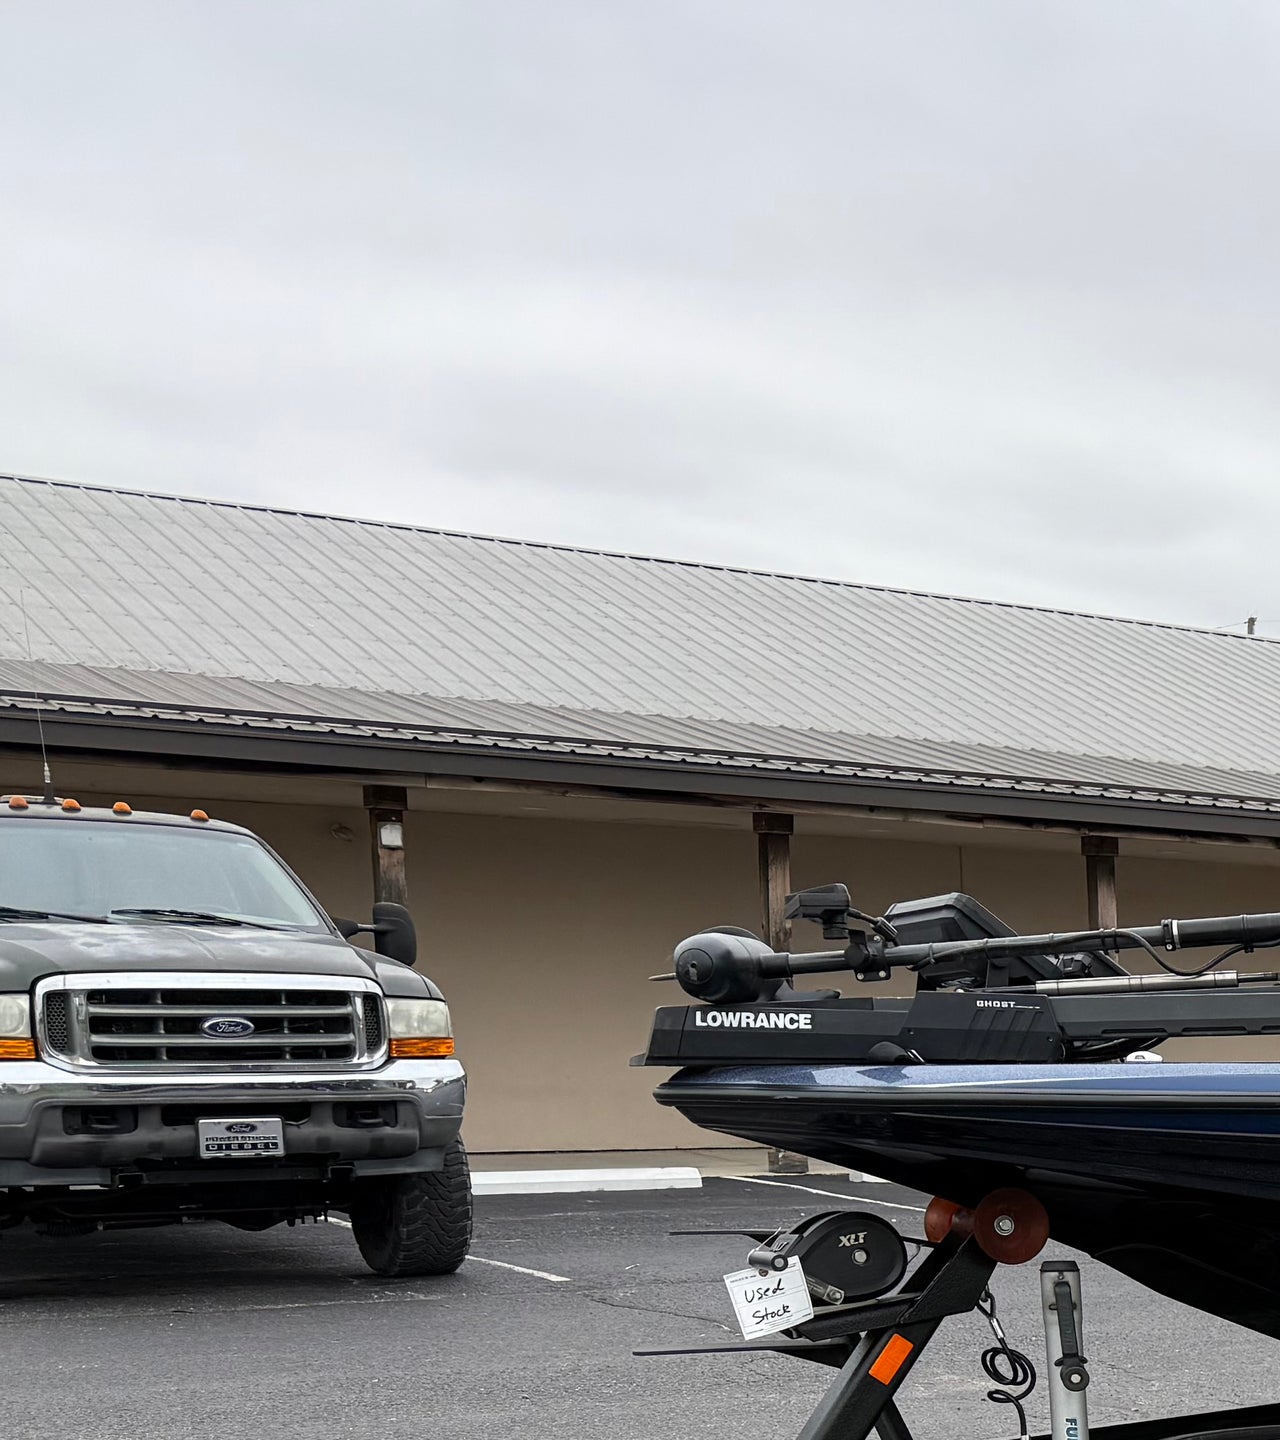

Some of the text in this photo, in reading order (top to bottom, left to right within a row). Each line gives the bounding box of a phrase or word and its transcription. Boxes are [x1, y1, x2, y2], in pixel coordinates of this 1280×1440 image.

[695, 999, 1017, 1030] LOWRANCE GHOST
[216, 1021, 244, 1034] Ford
[208, 1142, 277, 1150] DIESEL
[838, 1231, 868, 1248] XLT
[744, 1278, 785, 1303] Used
[752, 1303, 792, 1325] Stock
